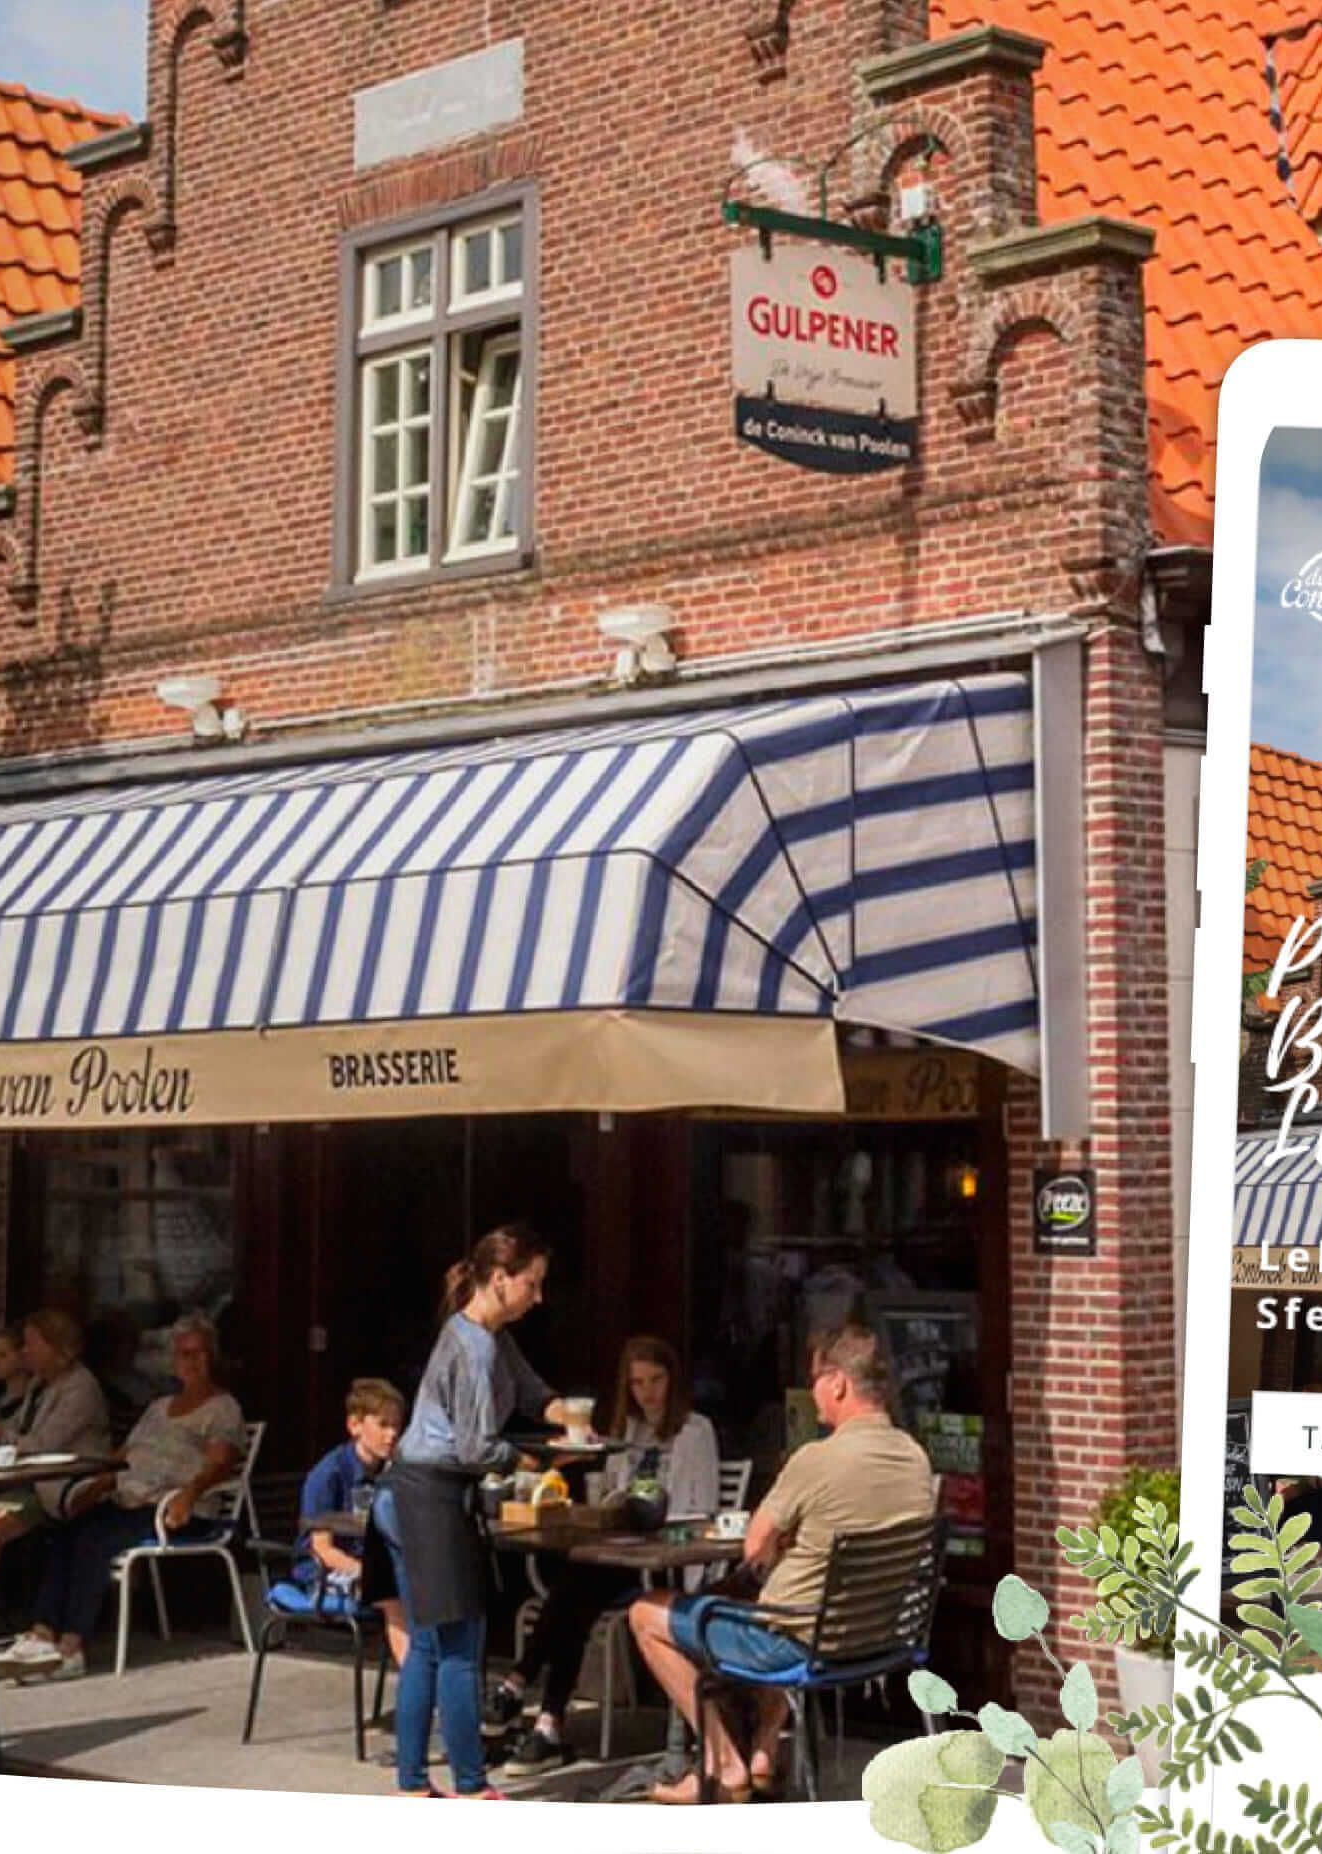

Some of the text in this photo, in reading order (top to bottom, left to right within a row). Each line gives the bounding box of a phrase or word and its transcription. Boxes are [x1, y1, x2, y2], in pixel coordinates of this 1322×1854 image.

[748, 297, 898, 357] GULPENER
[66, 1044, 194, 1116] Poolen
[329, 1048, 461, 1089] BRASSERIE
